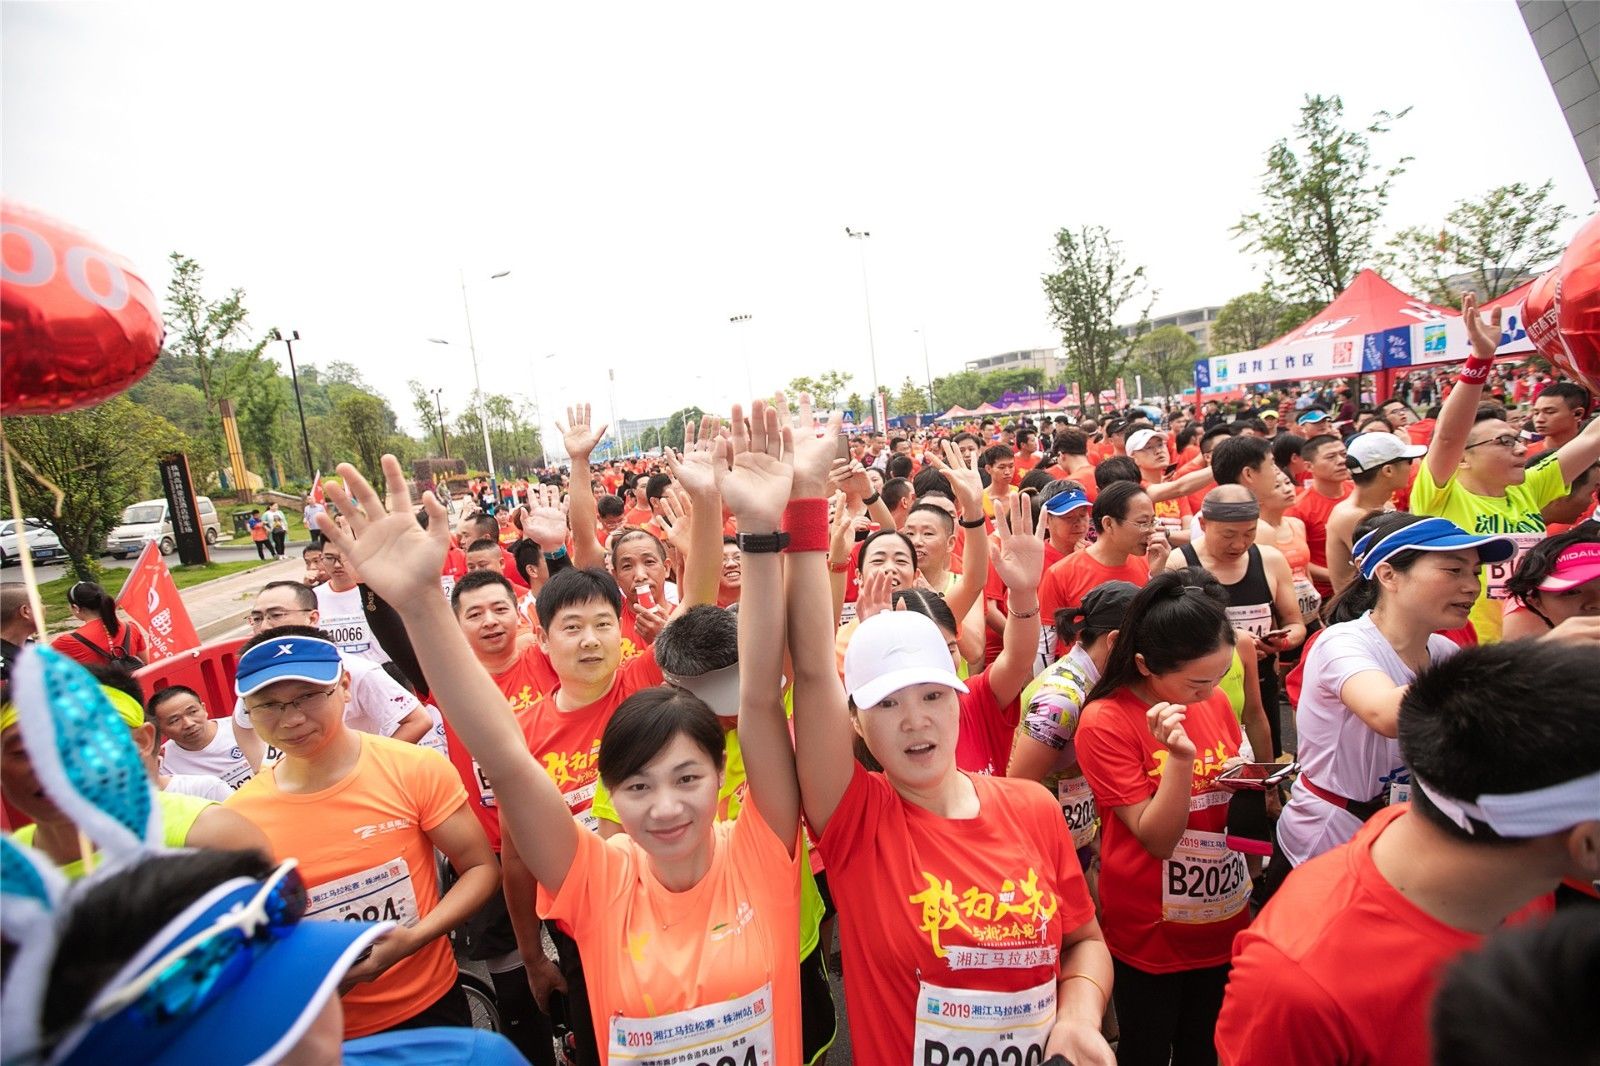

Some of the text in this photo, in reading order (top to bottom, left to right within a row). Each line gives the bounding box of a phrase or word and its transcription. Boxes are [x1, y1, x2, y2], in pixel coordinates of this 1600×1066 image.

[1238, 352, 1314, 374] 裁判工作区
[955, 949, 1052, 967] 湘江马拉松赛
